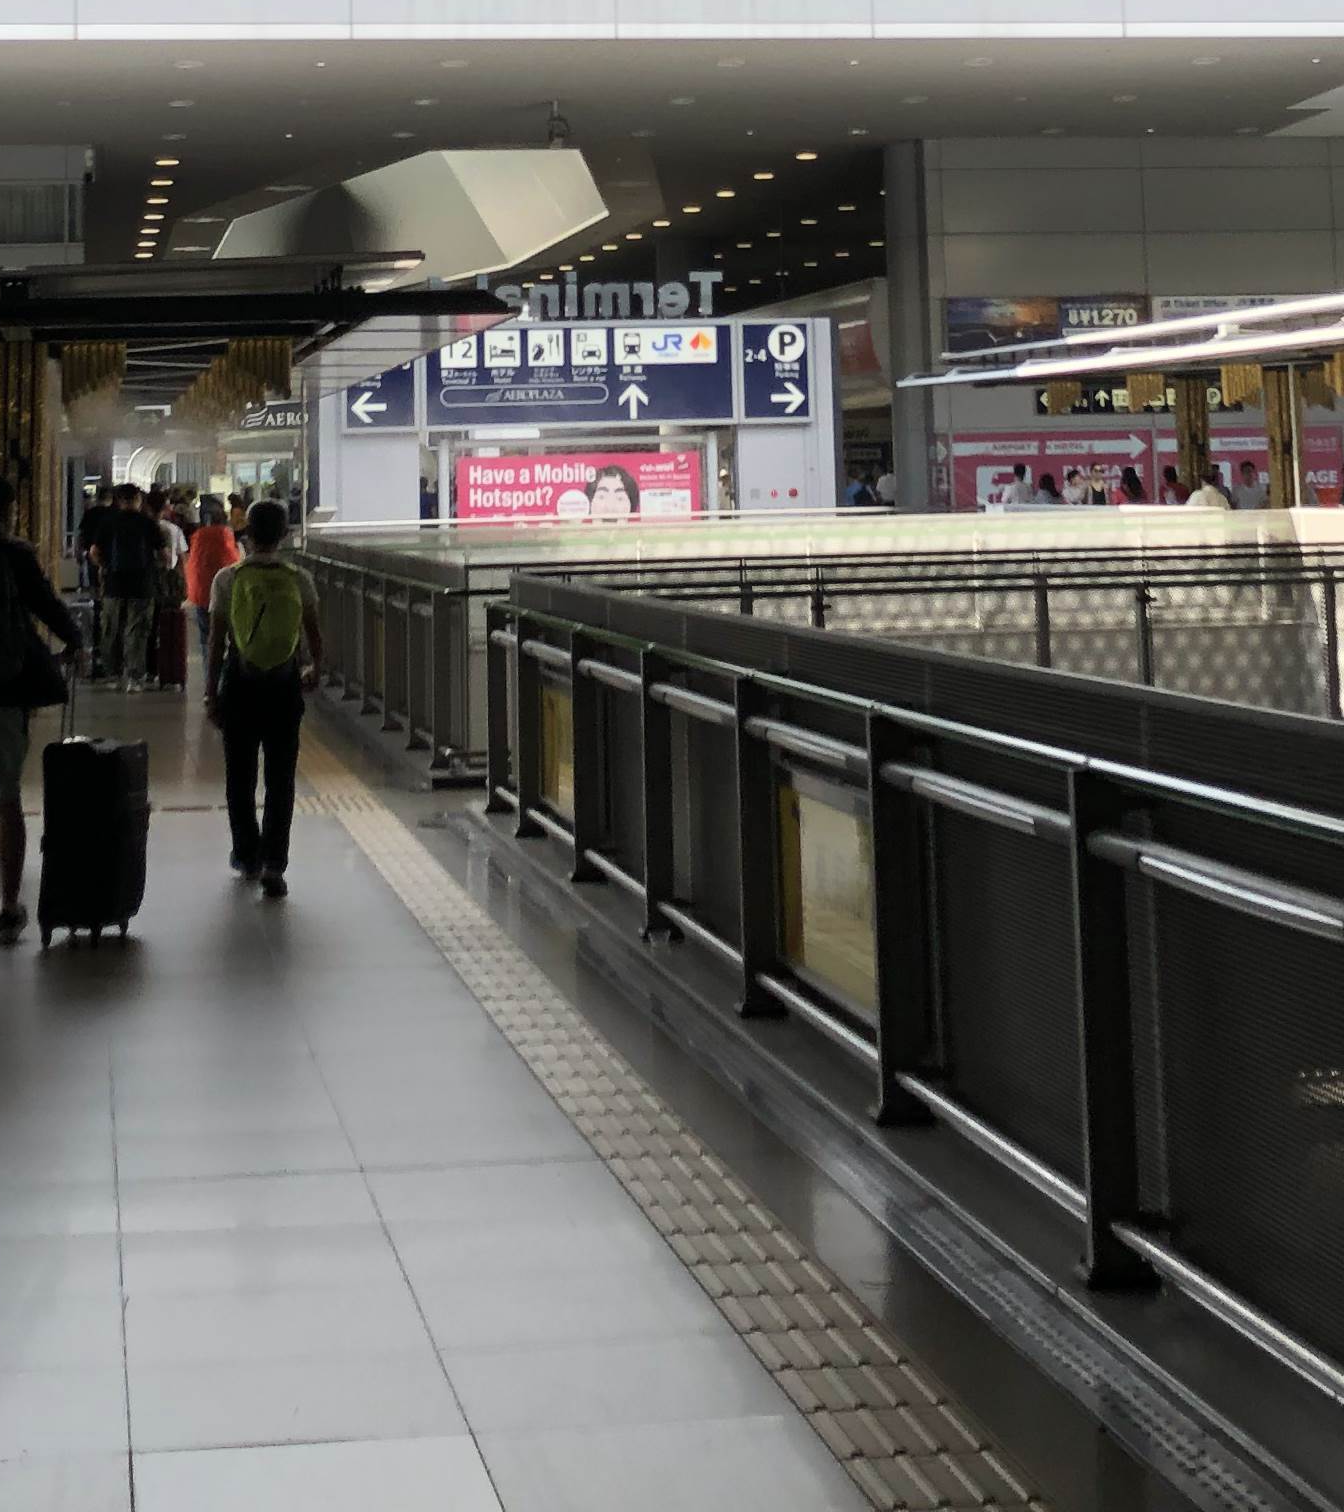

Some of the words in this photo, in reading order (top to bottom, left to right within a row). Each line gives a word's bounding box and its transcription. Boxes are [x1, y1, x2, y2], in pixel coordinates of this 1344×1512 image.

[651, 333, 683, 352] JR
[468, 464, 515, 486] Have
[518, 468, 531, 485] a
[534, 462, 597, 485] Mobile
[468, 485, 554, 510] Hotspot?
